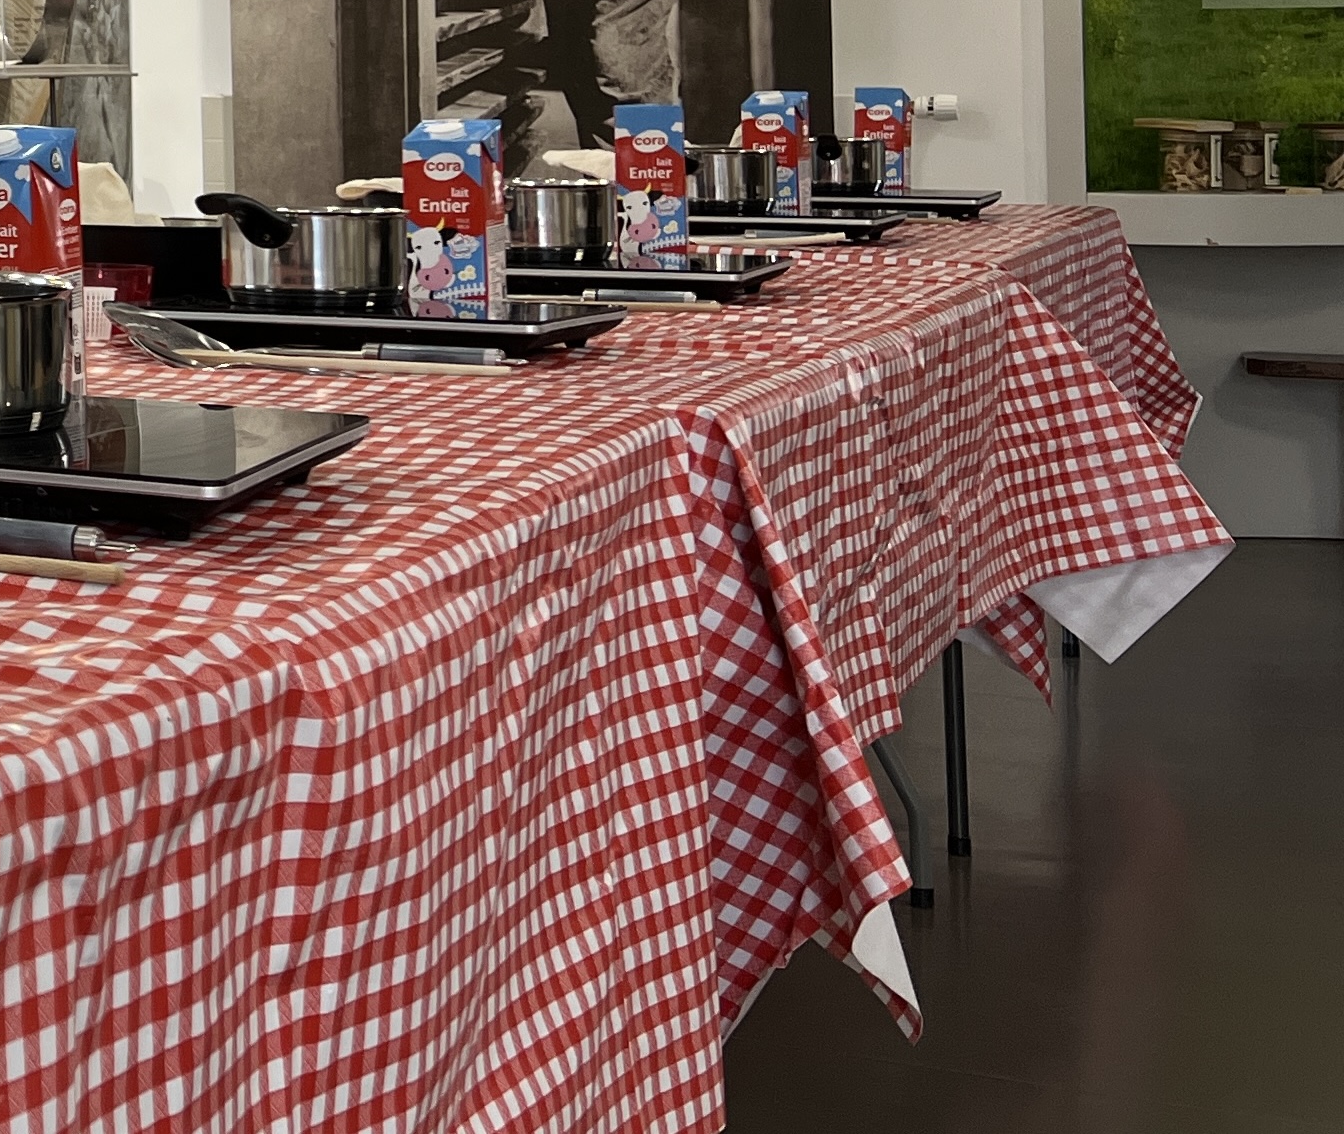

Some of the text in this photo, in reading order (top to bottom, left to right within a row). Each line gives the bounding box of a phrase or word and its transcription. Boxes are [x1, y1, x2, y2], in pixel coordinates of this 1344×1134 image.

[863, 129, 895, 140] Entier
[634, 137, 666, 146] cora
[752, 142, 787, 153] Entier
[426, 162, 462, 172] cora
[629, 166, 673, 179] Entier
[451, 187, 469, 198] lait
[419, 198, 470, 213] Entier
